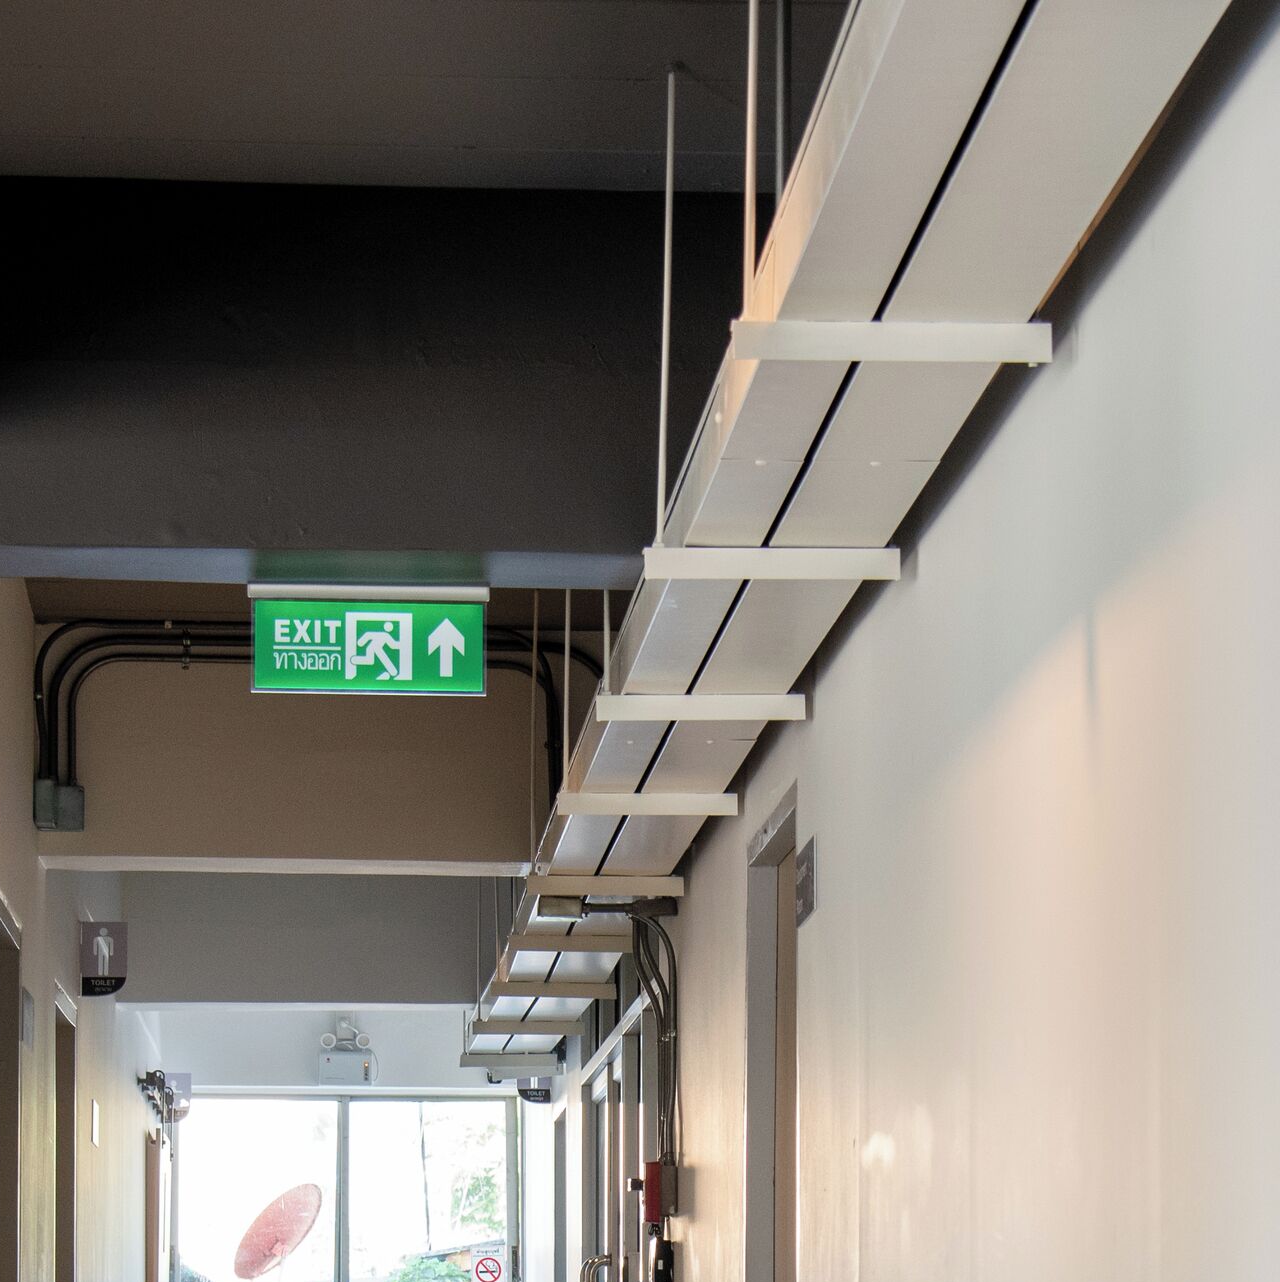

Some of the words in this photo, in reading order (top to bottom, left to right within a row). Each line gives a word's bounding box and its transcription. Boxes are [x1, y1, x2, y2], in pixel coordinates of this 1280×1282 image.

[274, 619, 341, 643] EXIT
[273, 651, 341, 671] ทางออก
